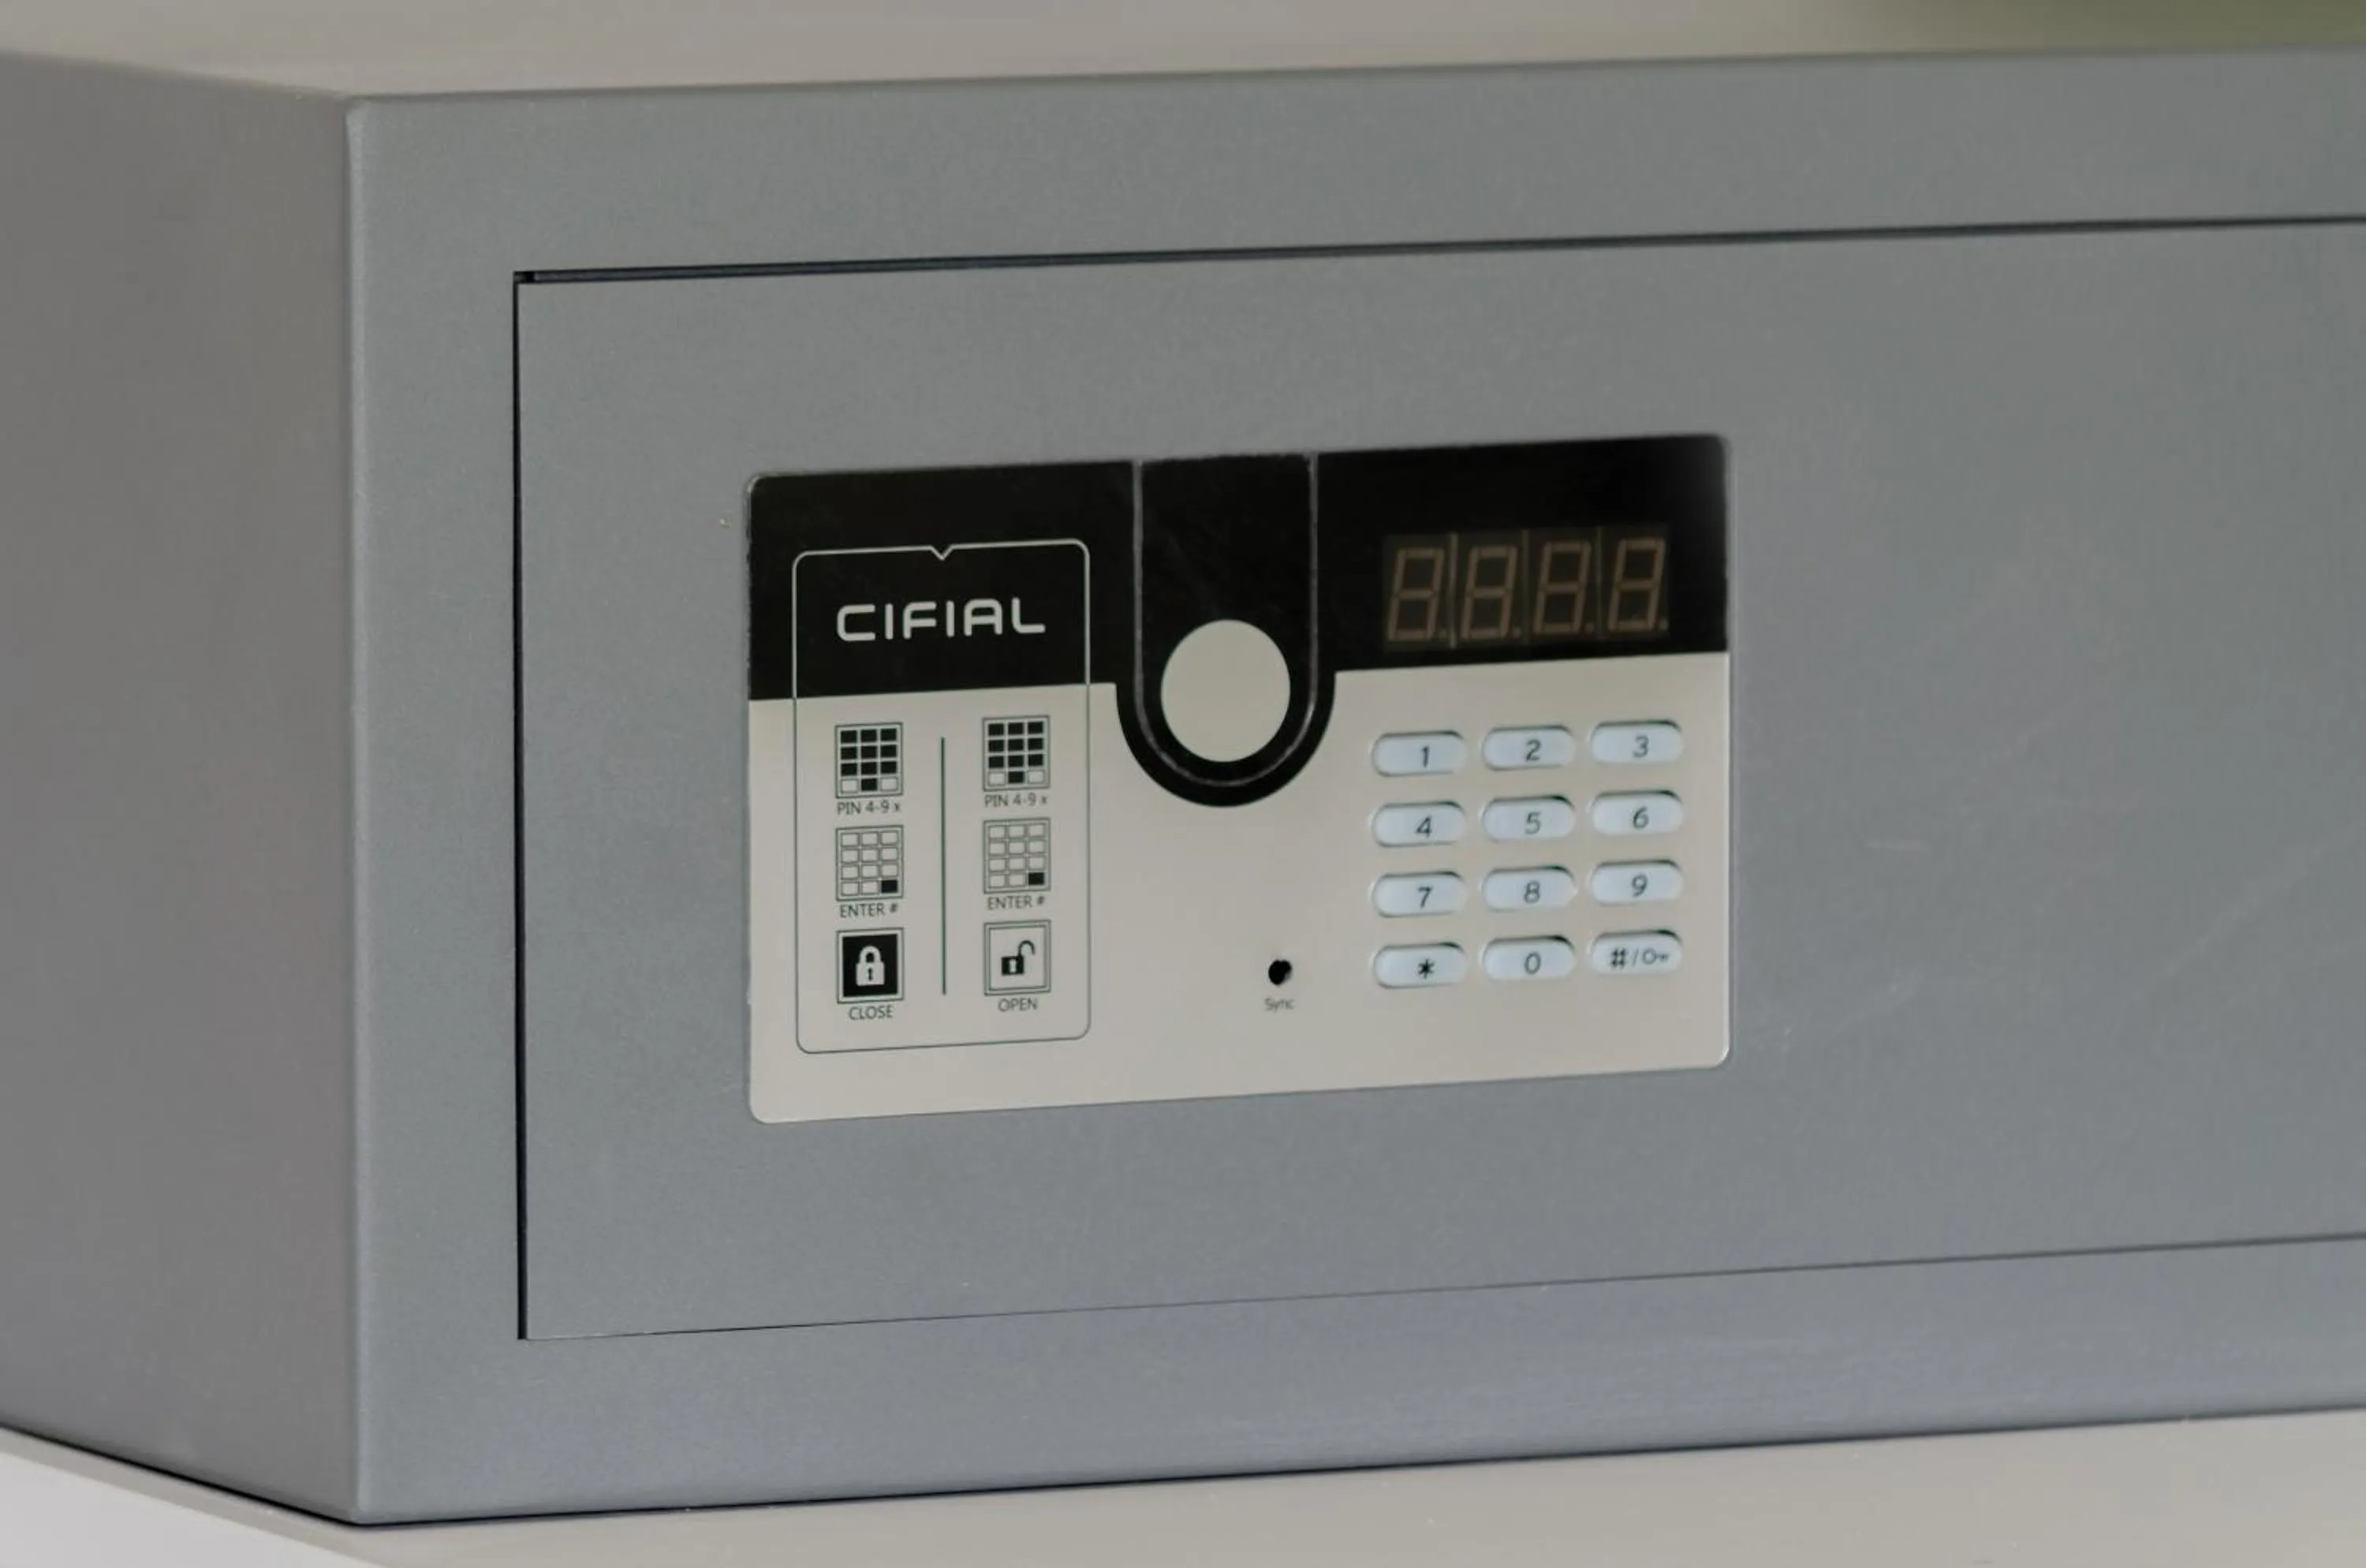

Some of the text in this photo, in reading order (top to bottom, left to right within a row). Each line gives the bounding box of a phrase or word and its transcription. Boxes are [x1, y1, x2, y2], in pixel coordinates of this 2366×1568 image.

[837, 597, 1046, 642] CIFIAL
[1420, 745, 1431, 768] 1
[1524, 739, 1543, 762] 2
[1633, 734, 1649, 759] 3
[837, 801, 863, 816] PIN
[865, 799, 891, 814] 4-9
[984, 794, 1009, 808] PIN
[1012, 792, 1037, 807] 4-9
[1416, 816, 1432, 838] 4
[1525, 811, 1541, 834] 5
[1632, 807, 1648, 829] 6
[1417, 886, 1433, 909] 7
[1523, 880, 1541, 903] 8
[1631, 874, 1648, 898] 9
[839, 902, 899, 919] ENTER #
[986, 894, 1046, 911] ENTER #
[1524, 951, 1542, 976] 0
[848, 1004, 894, 1021] CLOSE
[998, 997, 1039, 1013] OPEN
